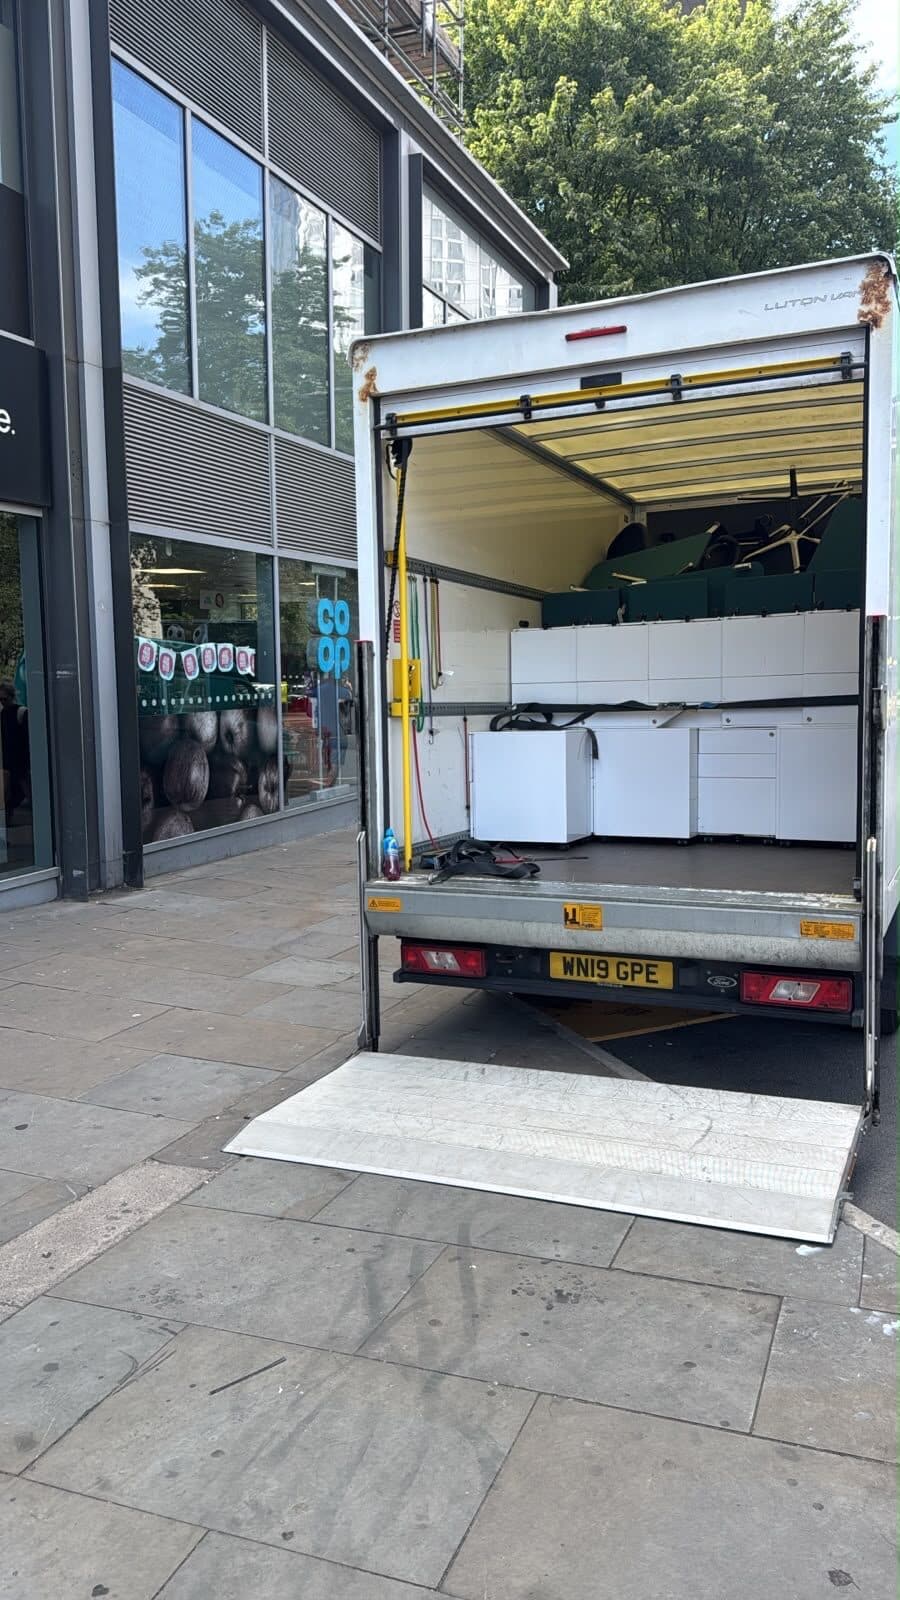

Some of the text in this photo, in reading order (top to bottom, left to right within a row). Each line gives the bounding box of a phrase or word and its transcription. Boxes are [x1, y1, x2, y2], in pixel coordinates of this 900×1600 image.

[764, 294, 828, 311] LUTON
[562, 956, 659, 984] WN19 GPE
